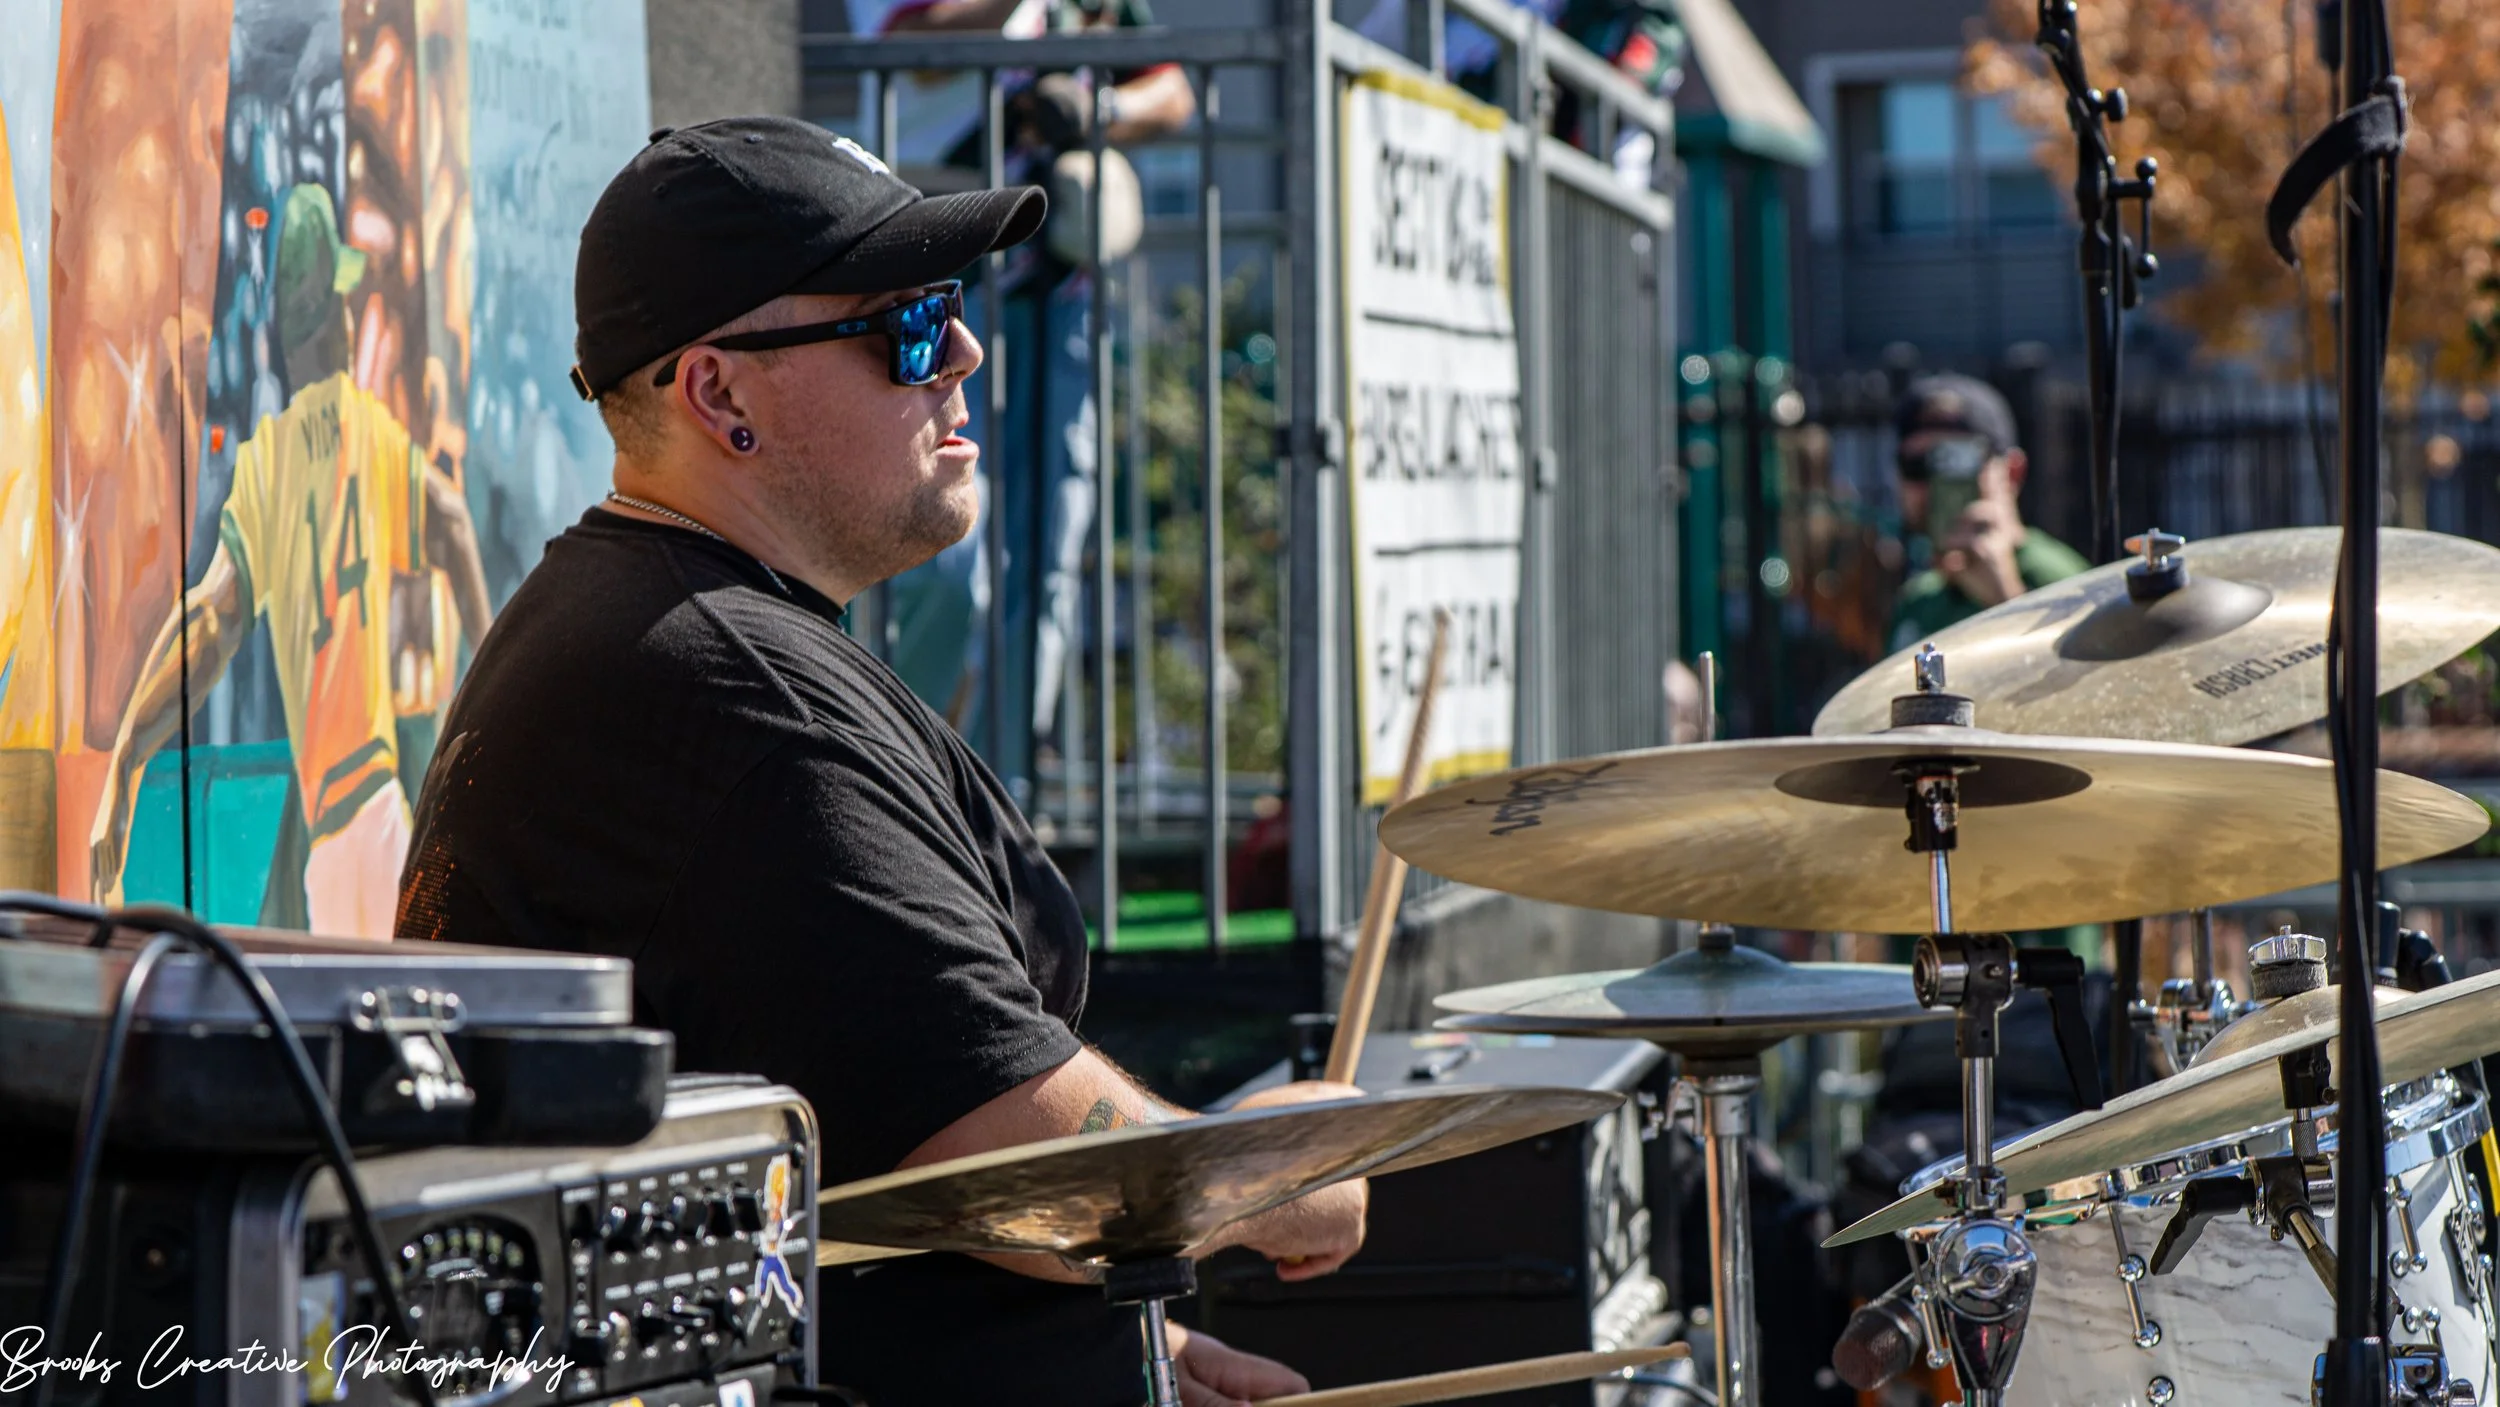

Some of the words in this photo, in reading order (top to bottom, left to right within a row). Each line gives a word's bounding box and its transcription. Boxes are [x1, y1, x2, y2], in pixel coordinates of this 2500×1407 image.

[306, 473, 368, 655] 14
[2272, 643, 2327, 669] WEET
[2193, 657, 2277, 699] CRASH
